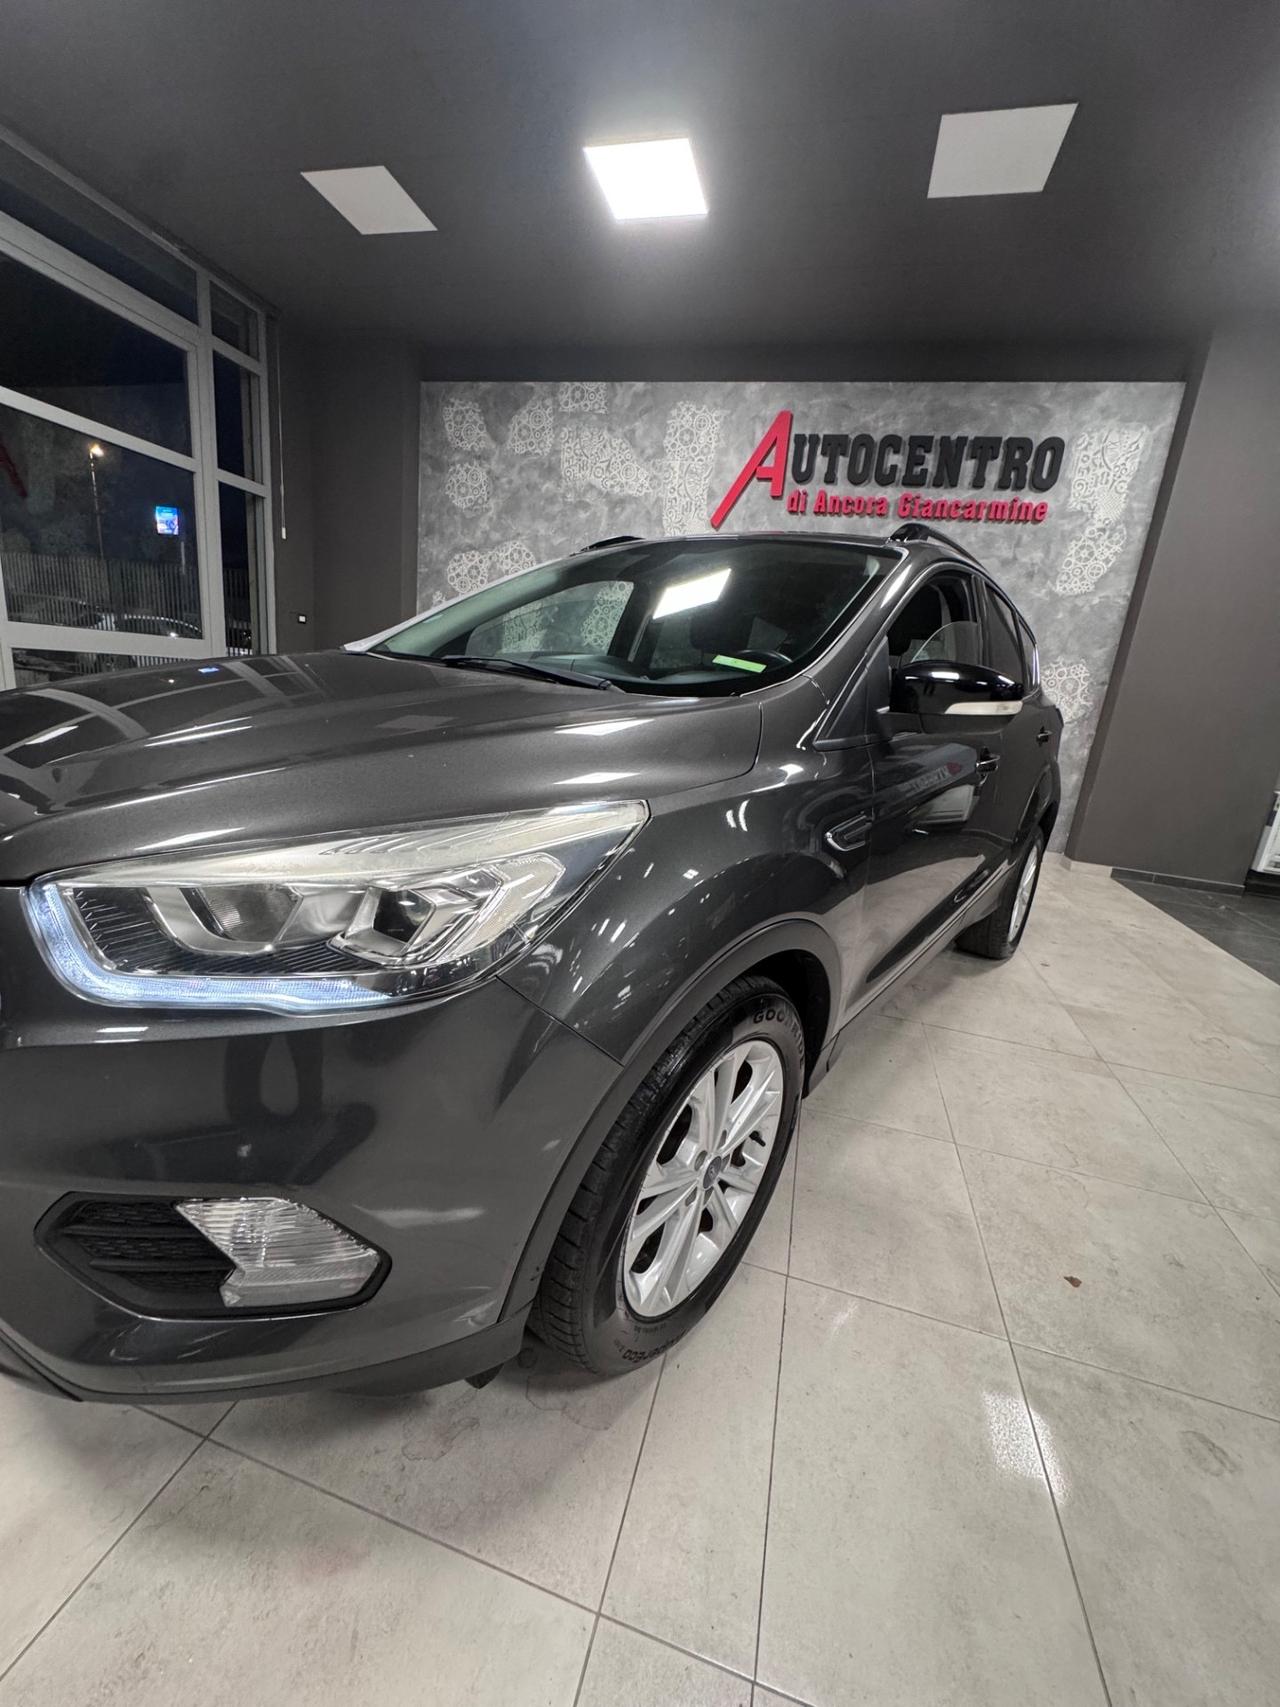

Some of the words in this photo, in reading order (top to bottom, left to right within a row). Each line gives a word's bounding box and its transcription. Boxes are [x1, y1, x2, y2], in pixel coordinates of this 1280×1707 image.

[711, 410, 1065, 529] AUTOCENTRO
[787, 489, 808, 514] di
[813, 489, 889, 517] Ancora
[897, 492, 1049, 523] Giancarmine
